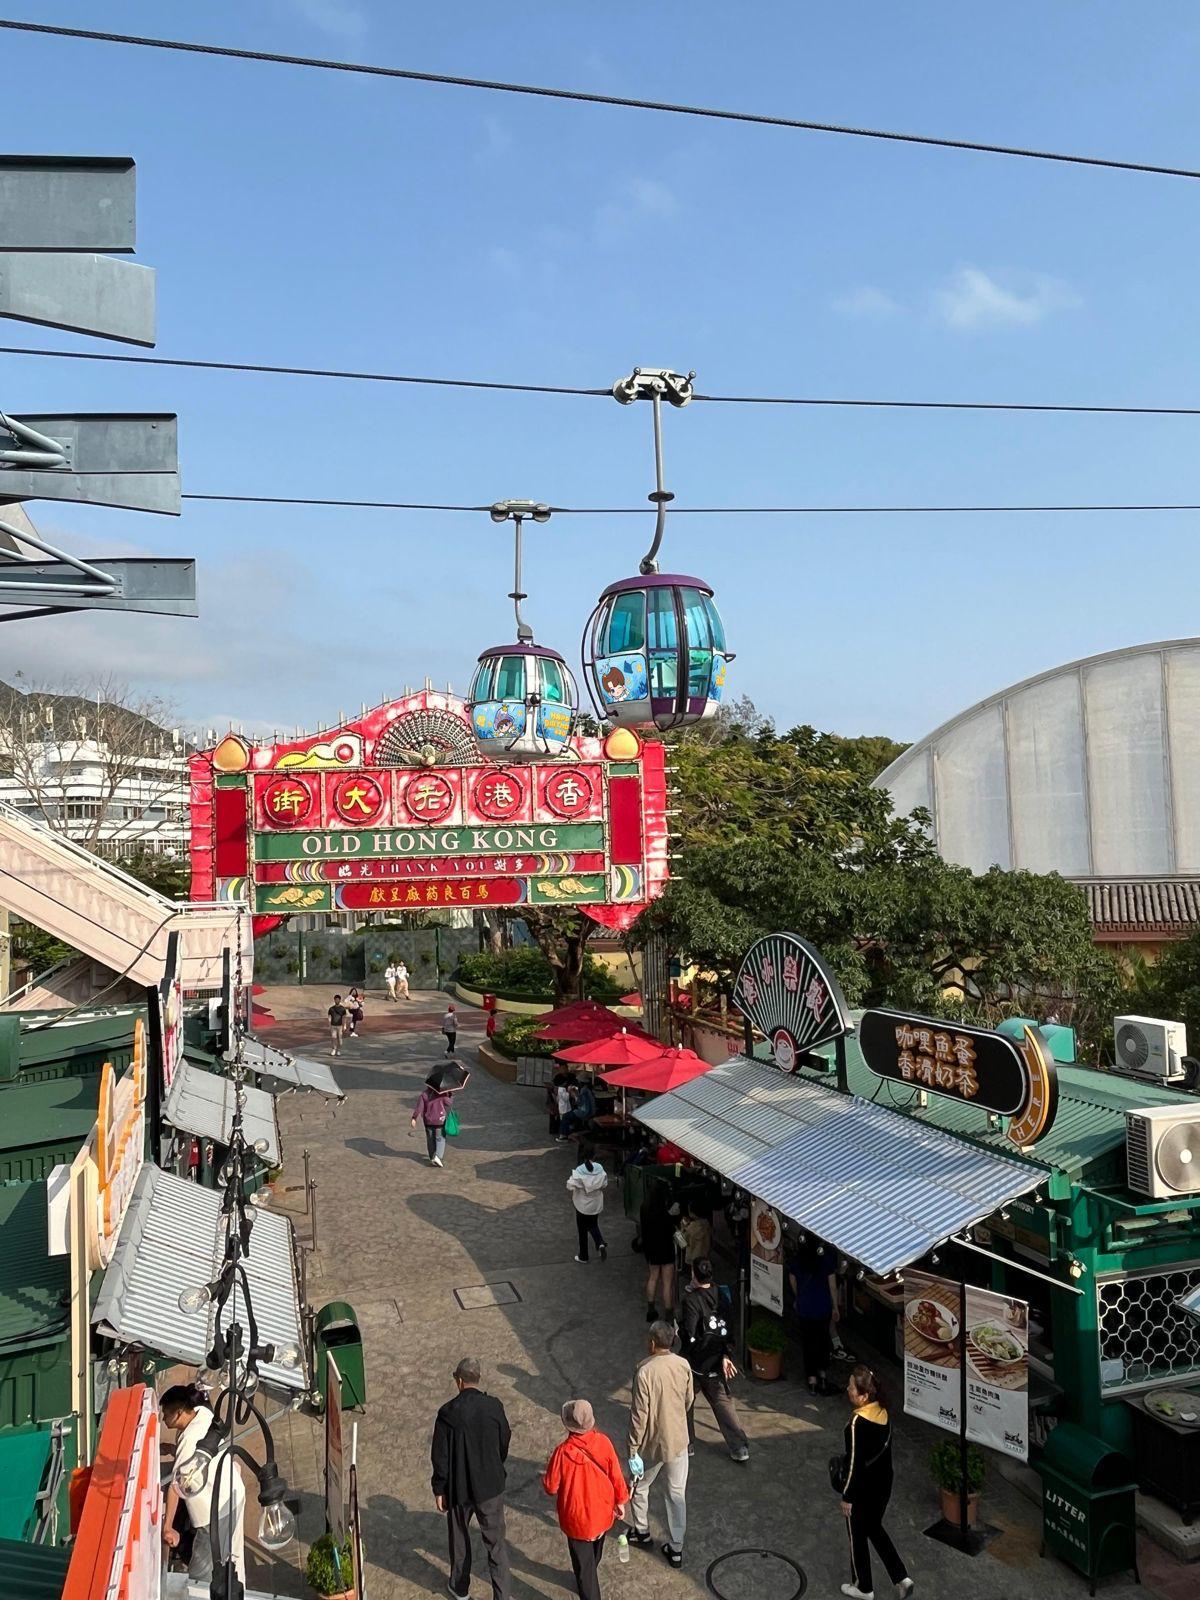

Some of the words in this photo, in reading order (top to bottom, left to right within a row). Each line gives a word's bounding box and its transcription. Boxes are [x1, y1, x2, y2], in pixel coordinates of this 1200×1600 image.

[302, 835, 361, 854] OLD
[372, 831, 461, 853] HONG
[472, 828, 558, 850] KONG
[895, 1024, 975, 1067] 咖哩魚蛋
[897, 1050, 978, 1098] 香滑奶茶
[1045, 1489, 1087, 1523] LITTER
